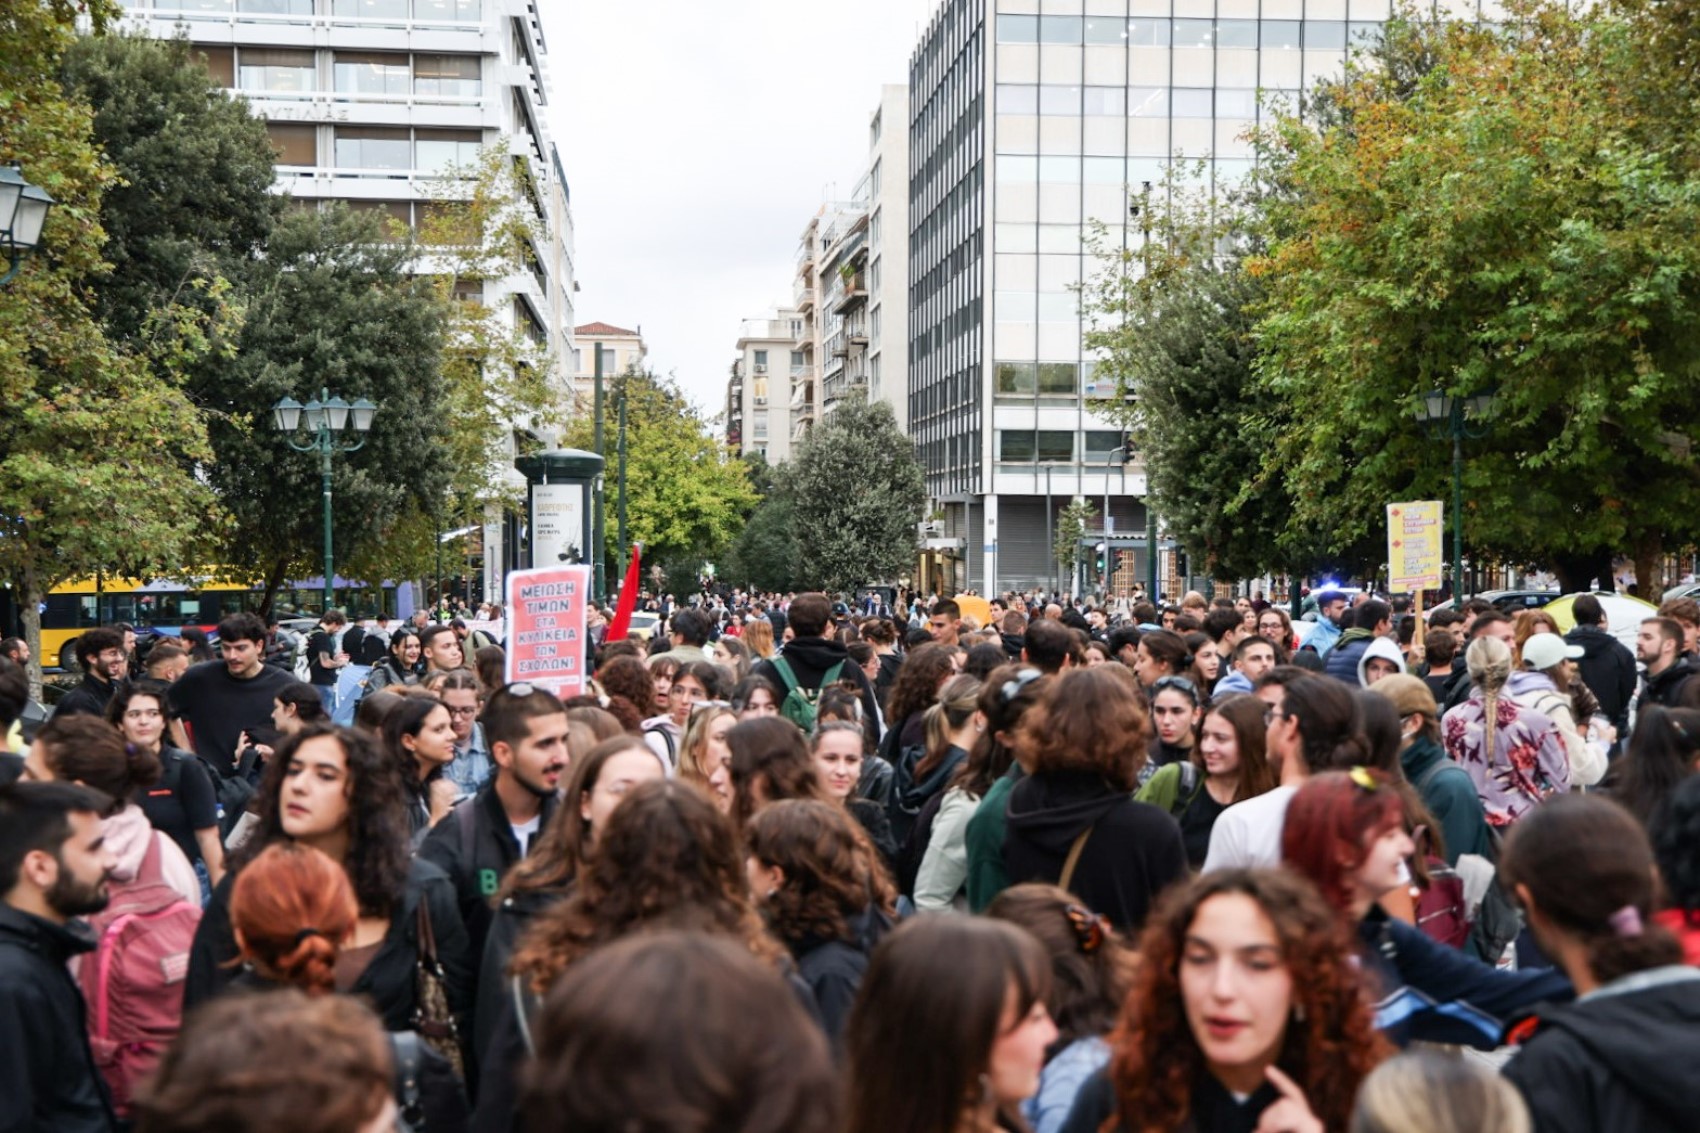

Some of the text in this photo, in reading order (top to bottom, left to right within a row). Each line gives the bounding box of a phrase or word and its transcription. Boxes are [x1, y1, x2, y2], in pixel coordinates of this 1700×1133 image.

[521, 582, 574, 598] ΜΕΙΩΣΗ
[526, 600, 569, 614] ΤΙΜΩΝ
[536, 617, 556, 627] ΣΤΑ
[518, 629, 576, 643] ΚΥΛΙΚΕΙΑ
[535, 646, 556, 656] ΤΩΝ
[519, 657, 574, 672] ΣΧΟΛΩΝ!
[480, 869, 499, 895] B
